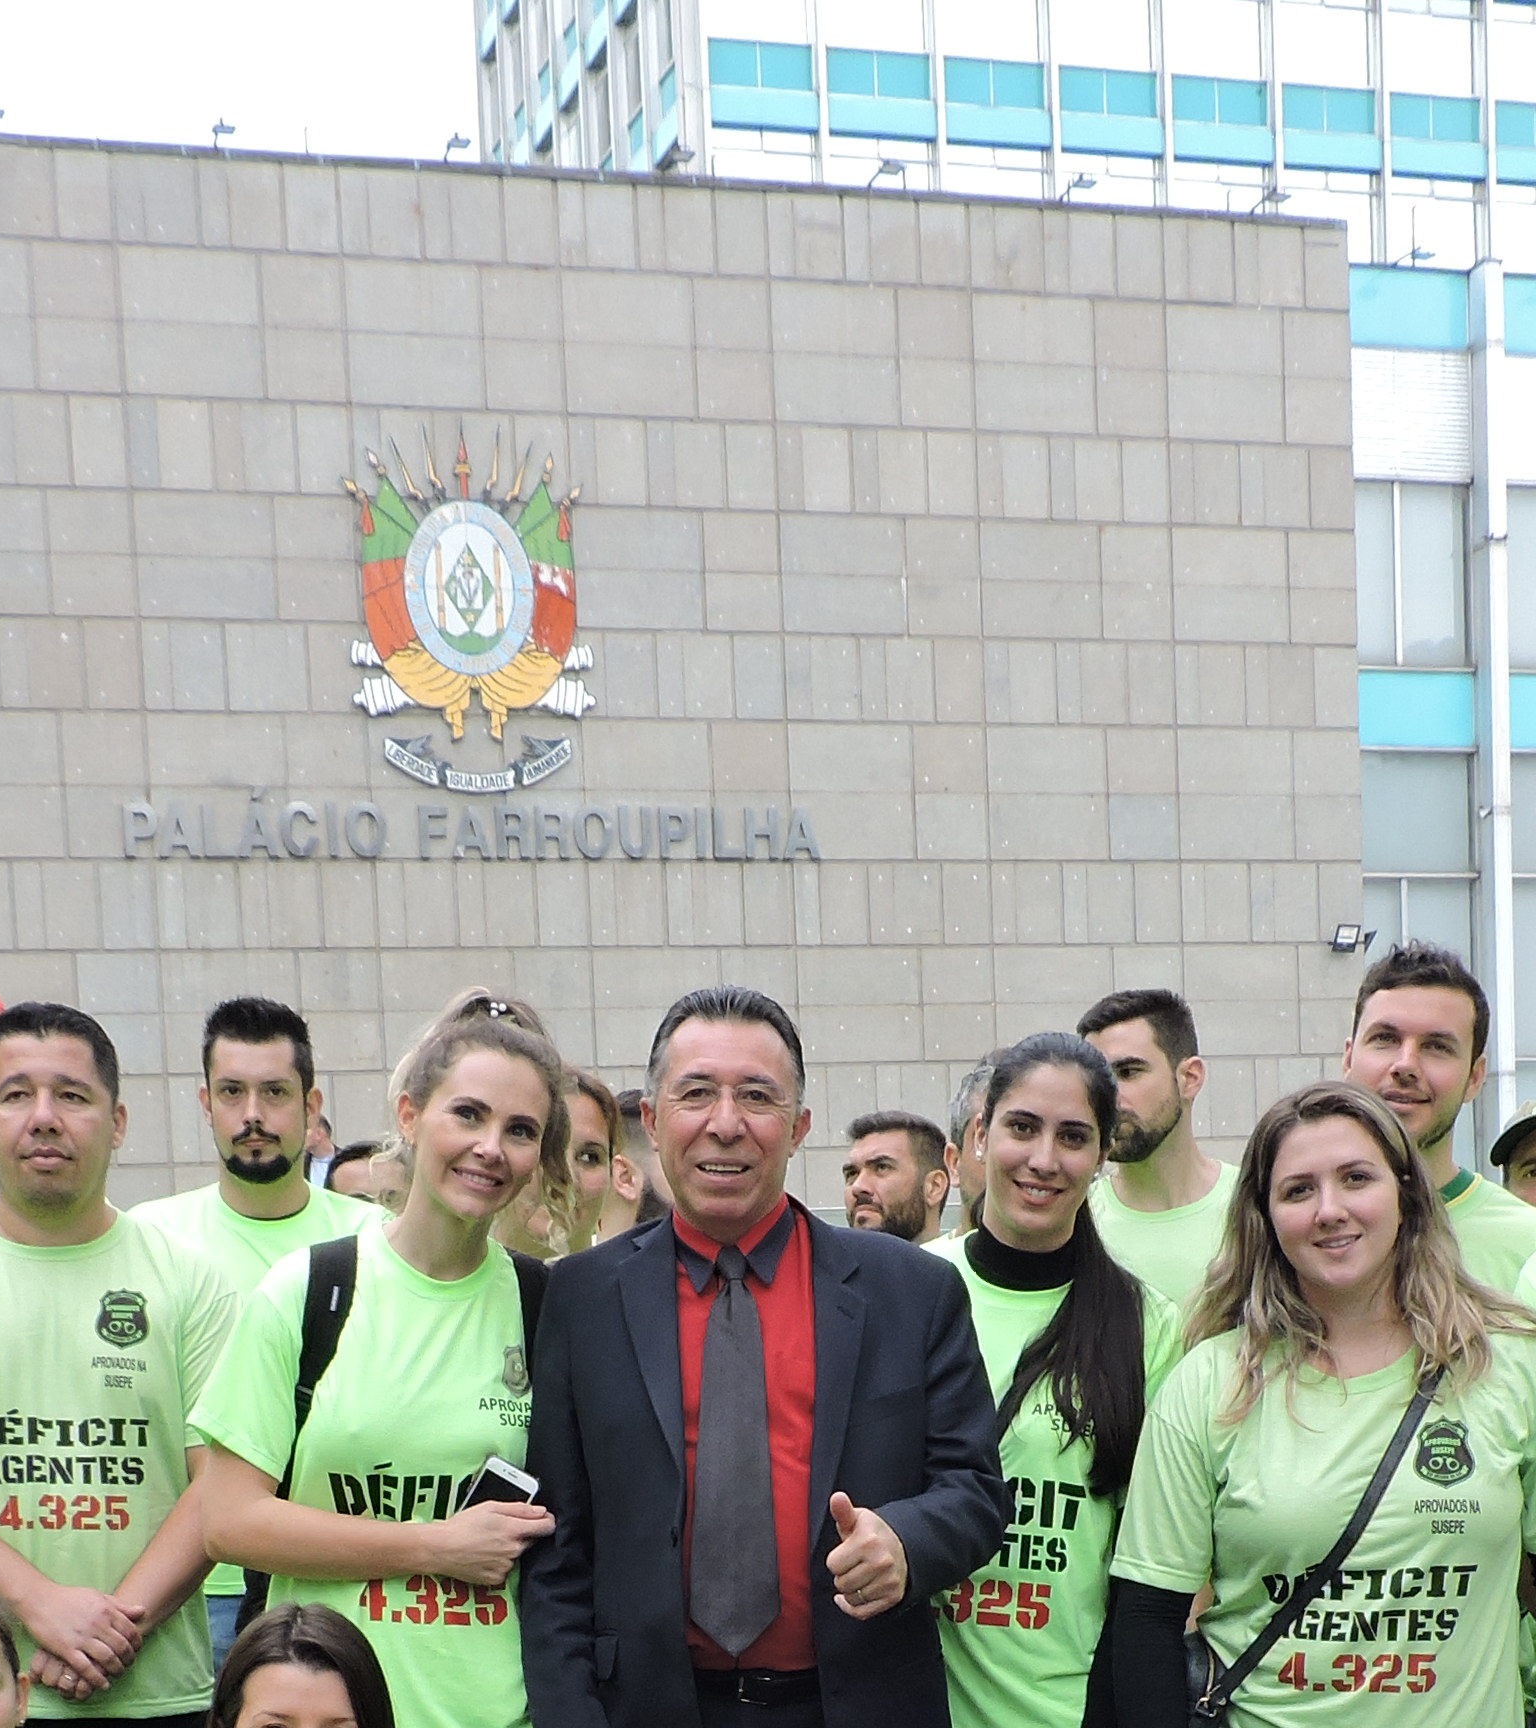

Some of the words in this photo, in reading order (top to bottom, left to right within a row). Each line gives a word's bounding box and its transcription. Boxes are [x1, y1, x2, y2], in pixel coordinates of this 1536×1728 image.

[450, 771, 510, 788] IGUALDADE
[122, 786, 388, 860] PALÁCIO
[418, 803, 822, 862] FARROUPILHA
[1414, 1499, 1468, 1514] APROVADOS
[1469, 1500, 1482, 1515] NA
[1431, 1520, 1466, 1535] SUSEPE
[1277, 1652, 1438, 1694] 4.325
